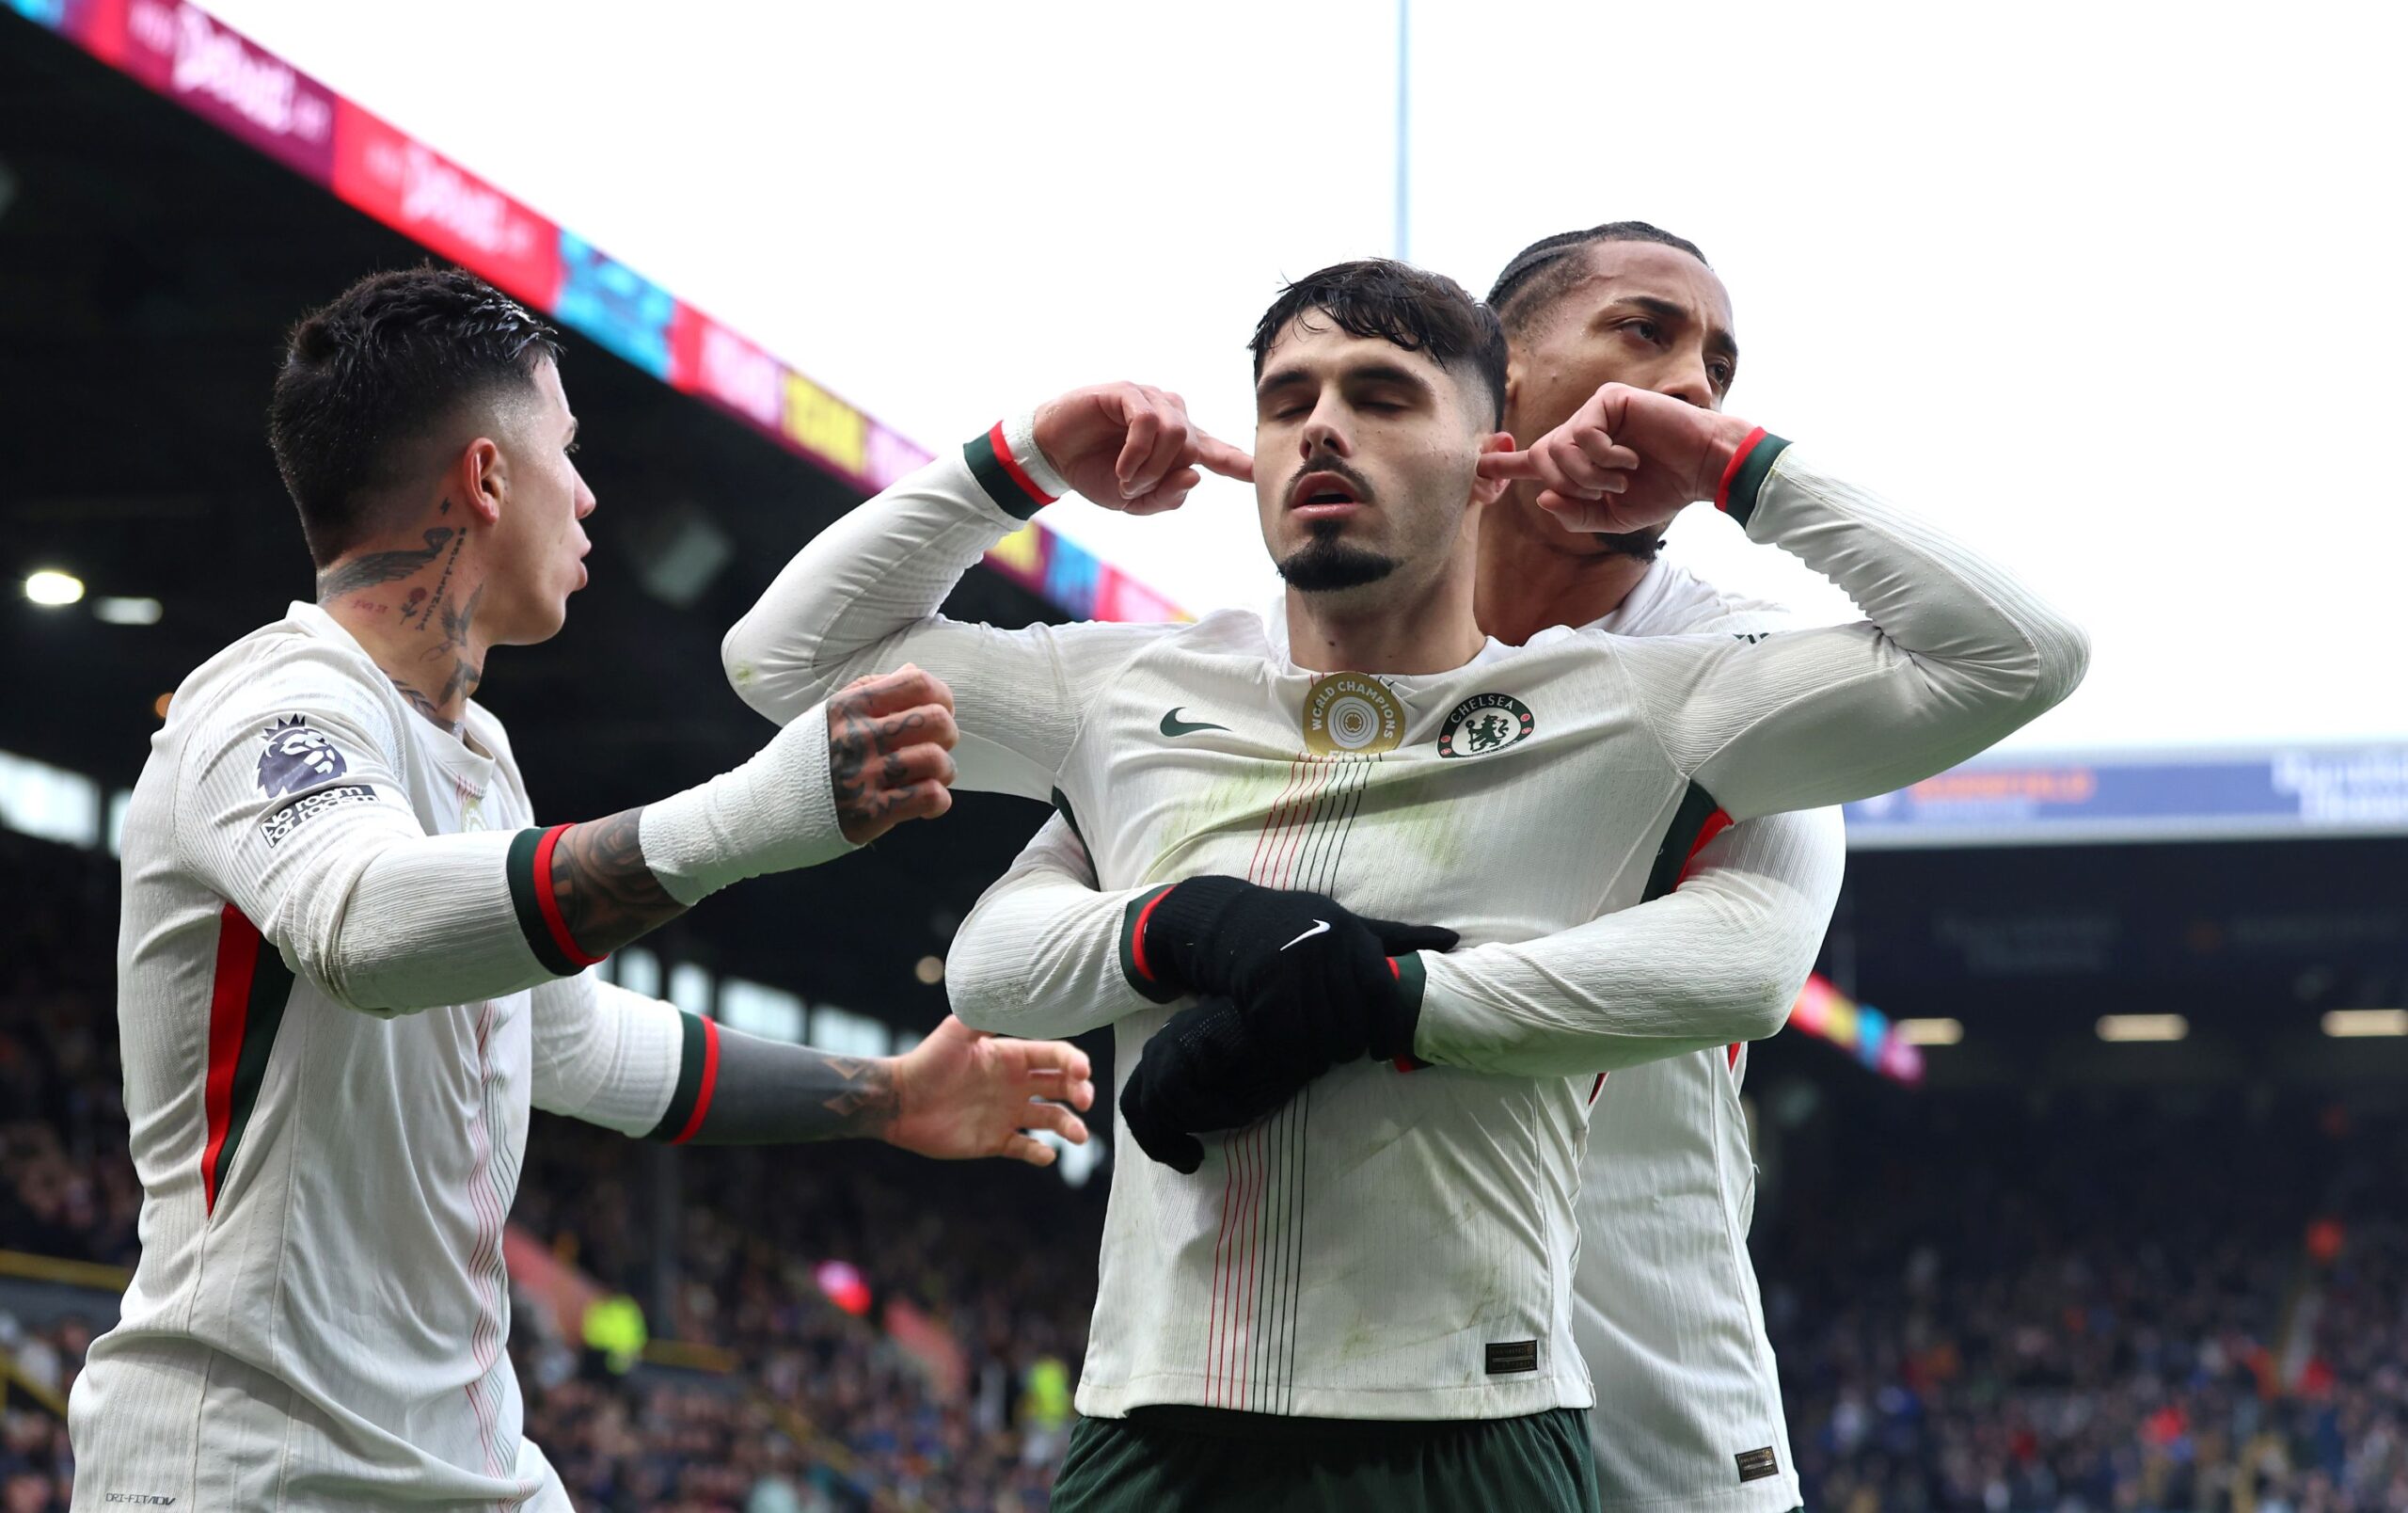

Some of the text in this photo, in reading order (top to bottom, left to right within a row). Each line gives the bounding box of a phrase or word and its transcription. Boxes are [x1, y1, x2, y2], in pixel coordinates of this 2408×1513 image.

[1312, 680, 1396, 739] WORLD CHAMPIONS
[1450, 695, 1513, 723] CHELSEA
[261, 787, 364, 837] No room
